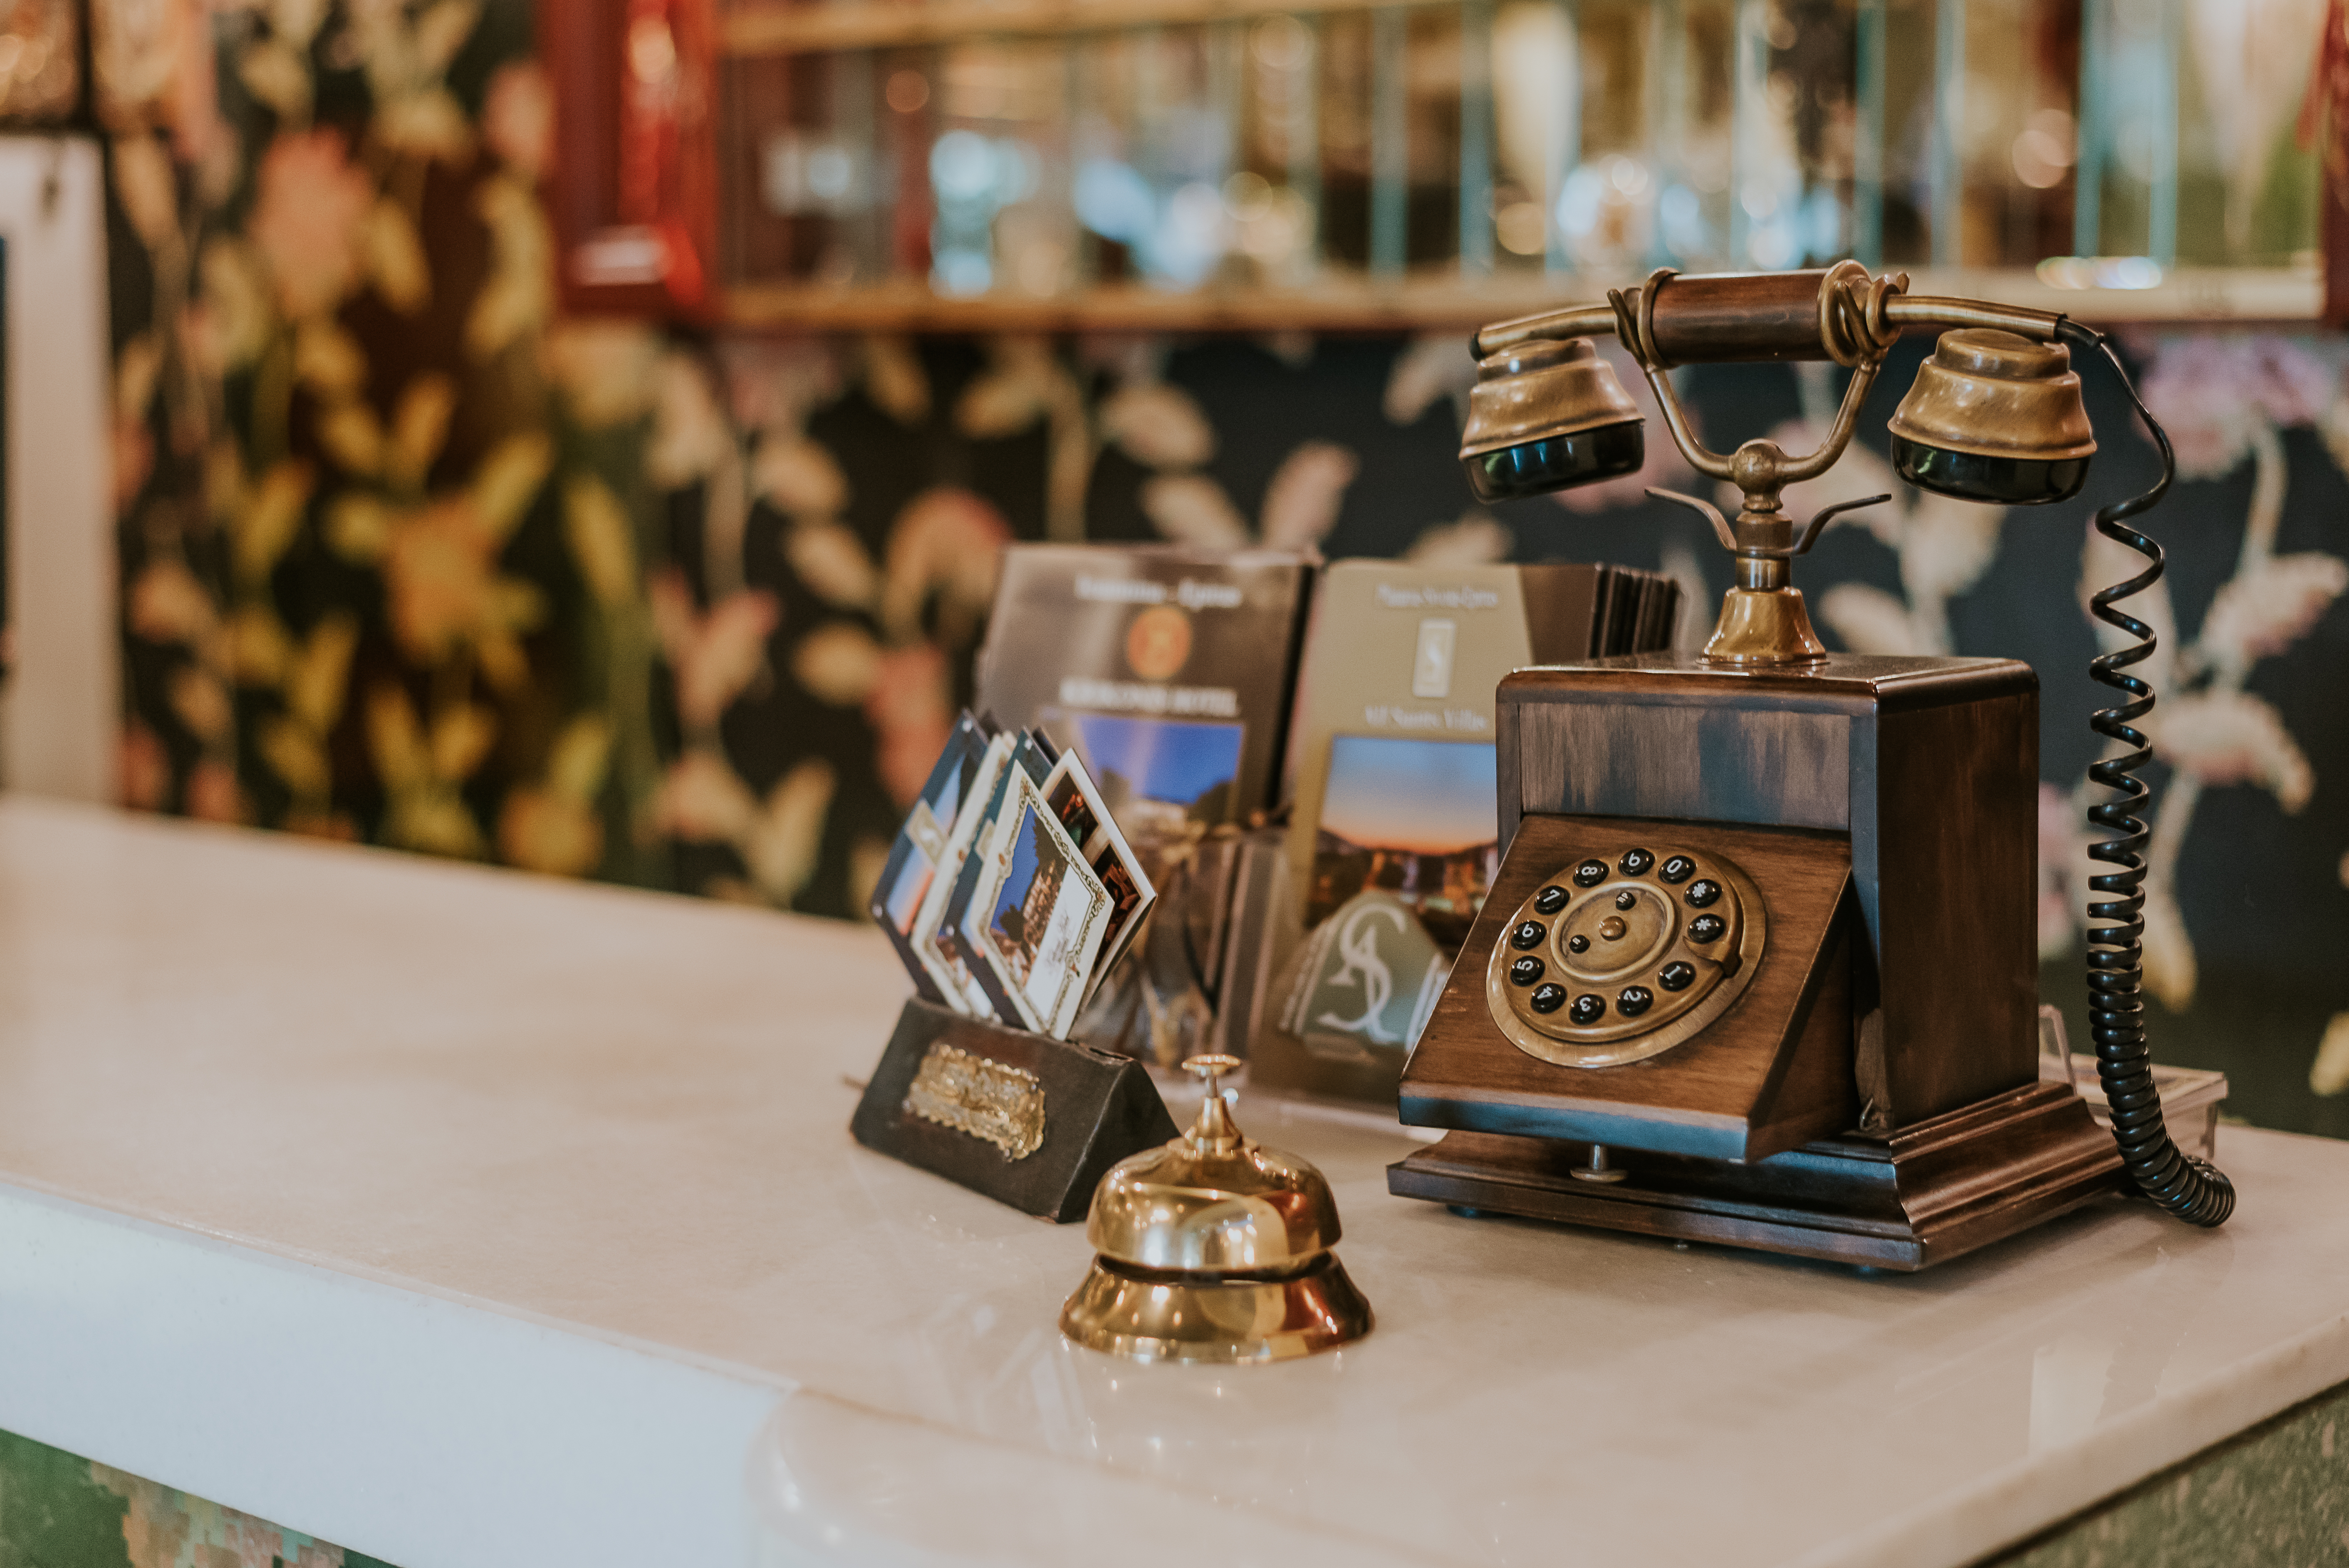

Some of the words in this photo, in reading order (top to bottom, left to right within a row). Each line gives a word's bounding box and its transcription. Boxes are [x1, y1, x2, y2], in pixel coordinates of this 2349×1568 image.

[1581, 866, 1598, 876] 8
[1517, 960, 1533, 971] 5
[1537, 986, 1552, 999] 4
[1623, 990, 1641, 1001] 2
[1579, 997, 1591, 1012] 3
